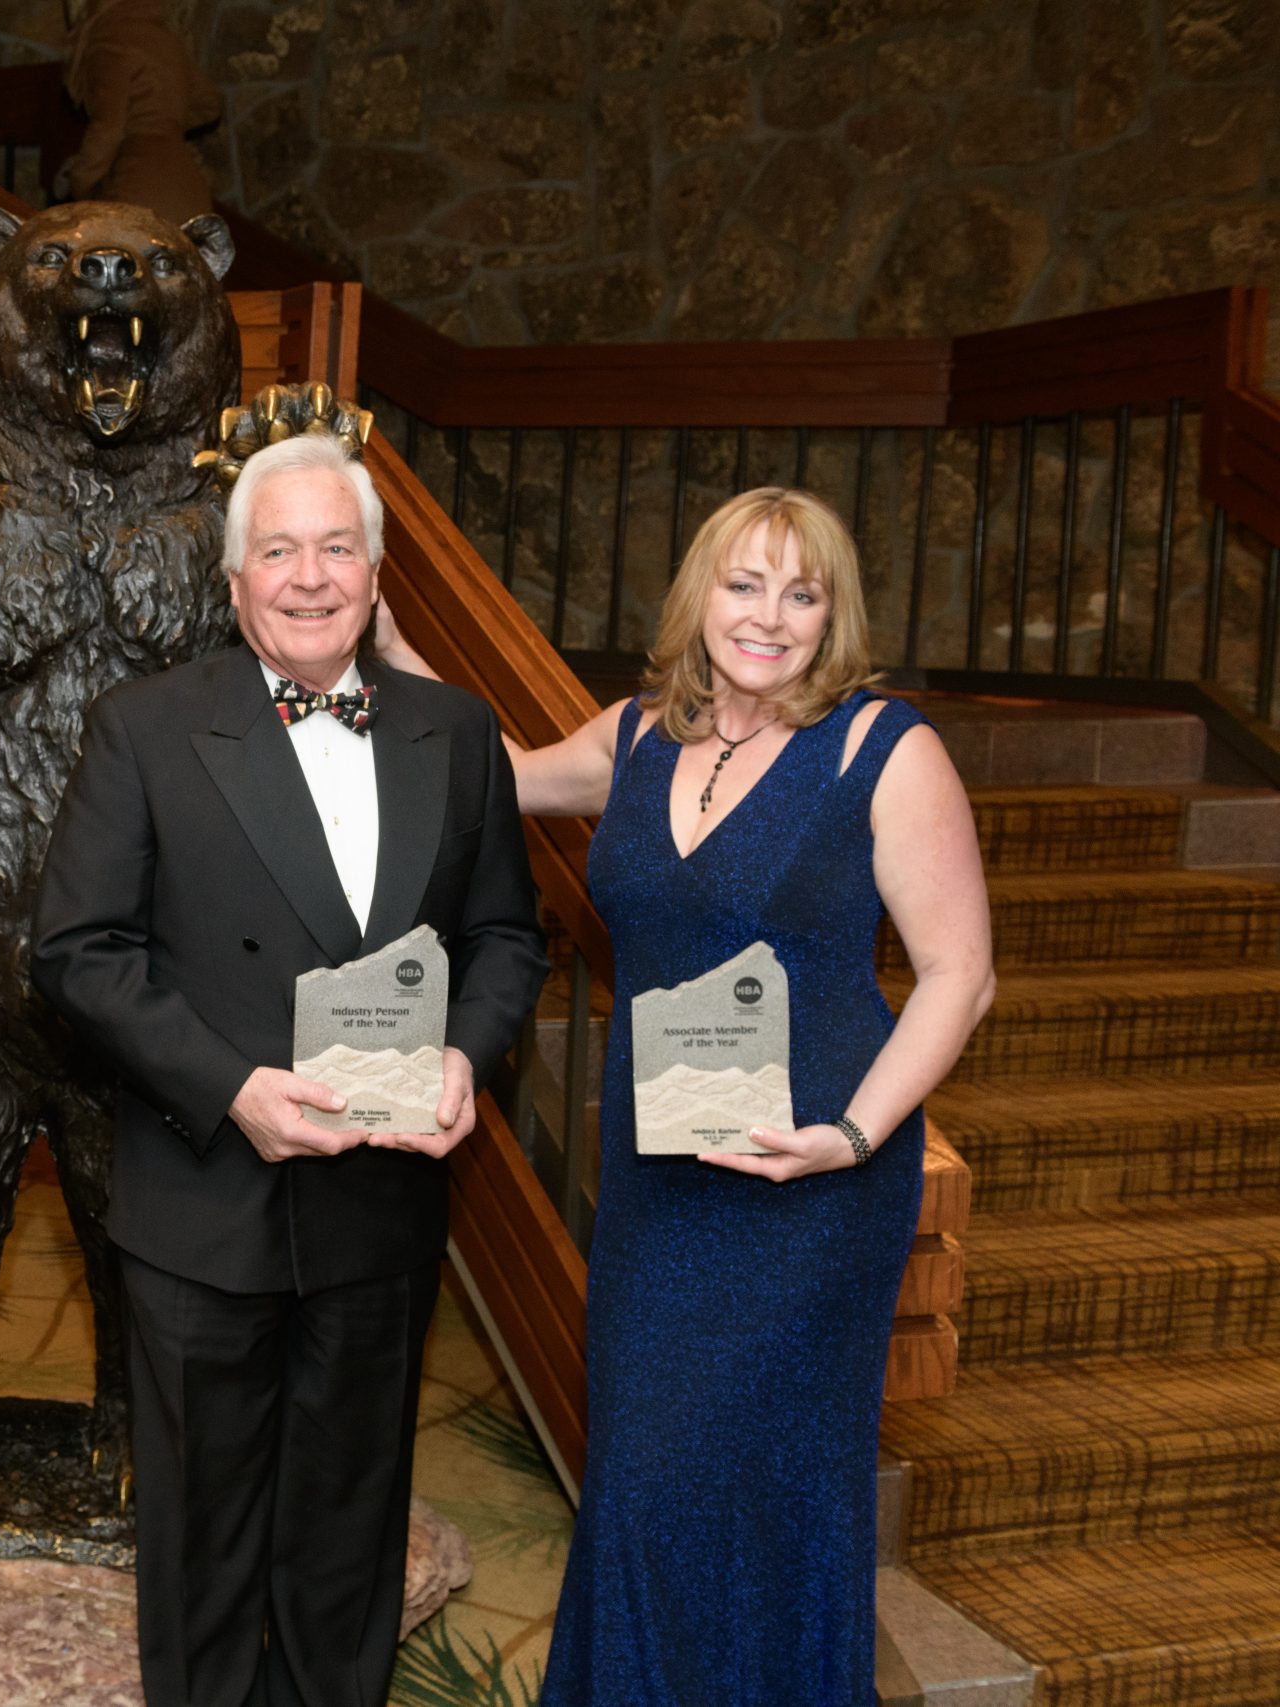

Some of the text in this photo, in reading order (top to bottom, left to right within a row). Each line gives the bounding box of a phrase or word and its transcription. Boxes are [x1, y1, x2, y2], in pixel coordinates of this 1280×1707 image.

[398, 968, 422, 978] HBA
[735, 985, 761, 995] HBA
[331, 1007, 410, 1017] Industry Person
[343, 1019, 398, 1028] of the Year
[663, 1025, 758, 1036] Associate Member
[682, 1039, 739, 1048] of the Year
